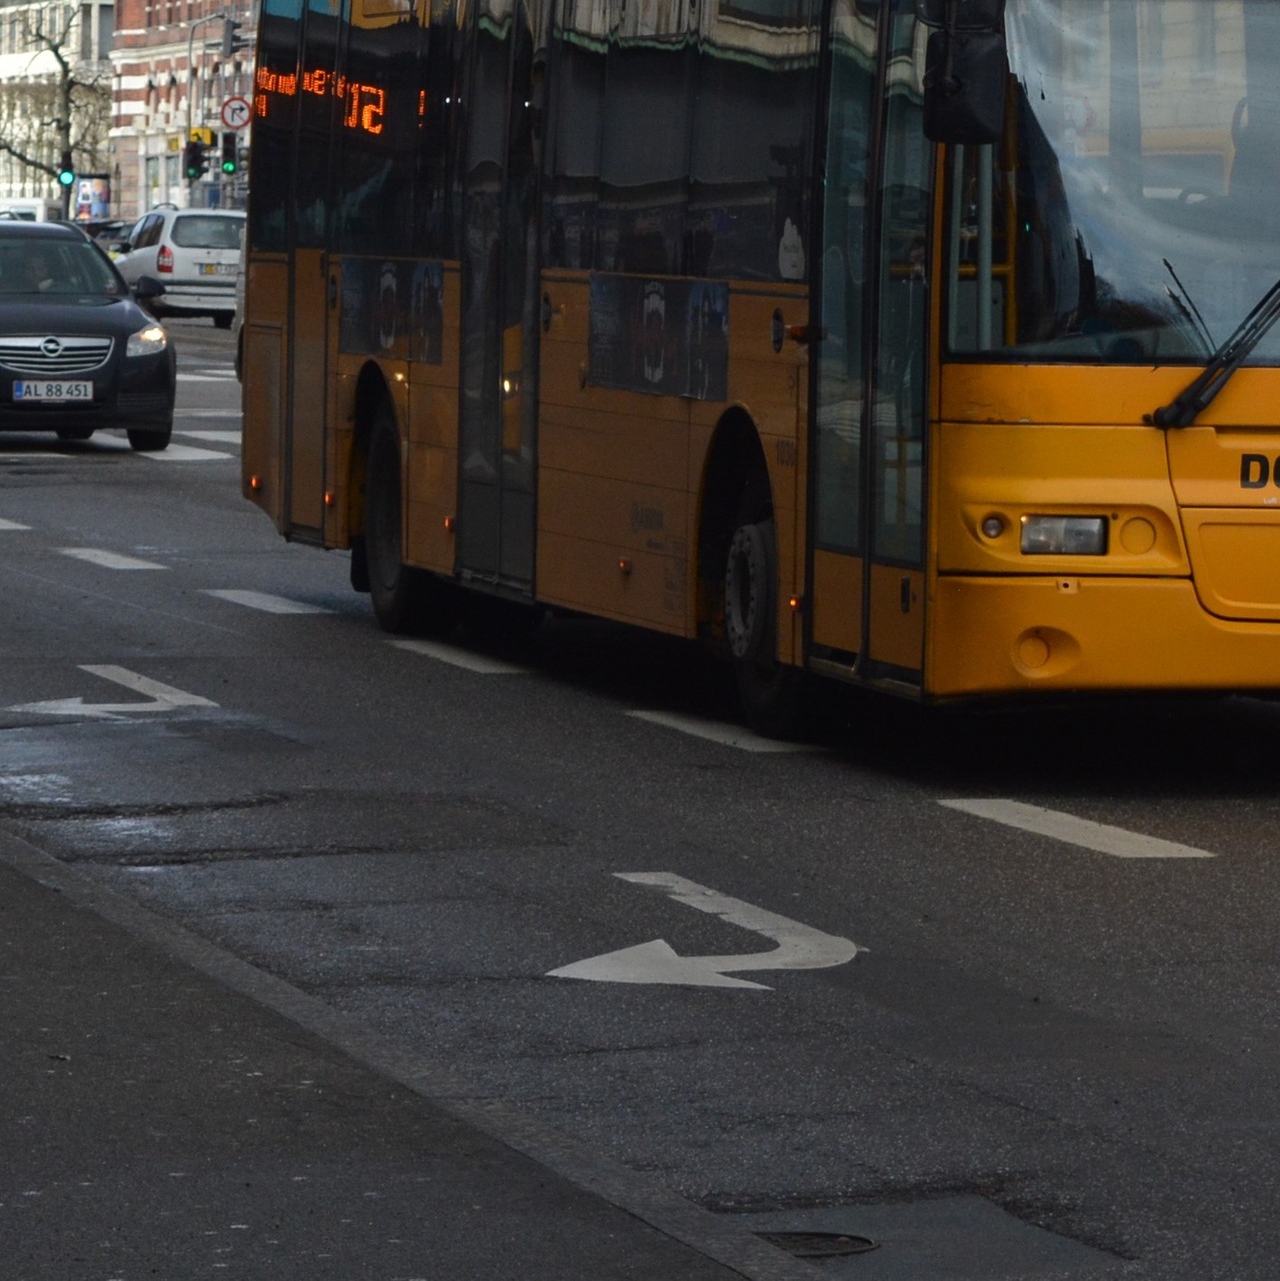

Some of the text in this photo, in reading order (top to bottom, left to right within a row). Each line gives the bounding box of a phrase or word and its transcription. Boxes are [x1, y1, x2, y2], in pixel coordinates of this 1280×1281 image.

[24, 383, 89, 398] AL 88 451
